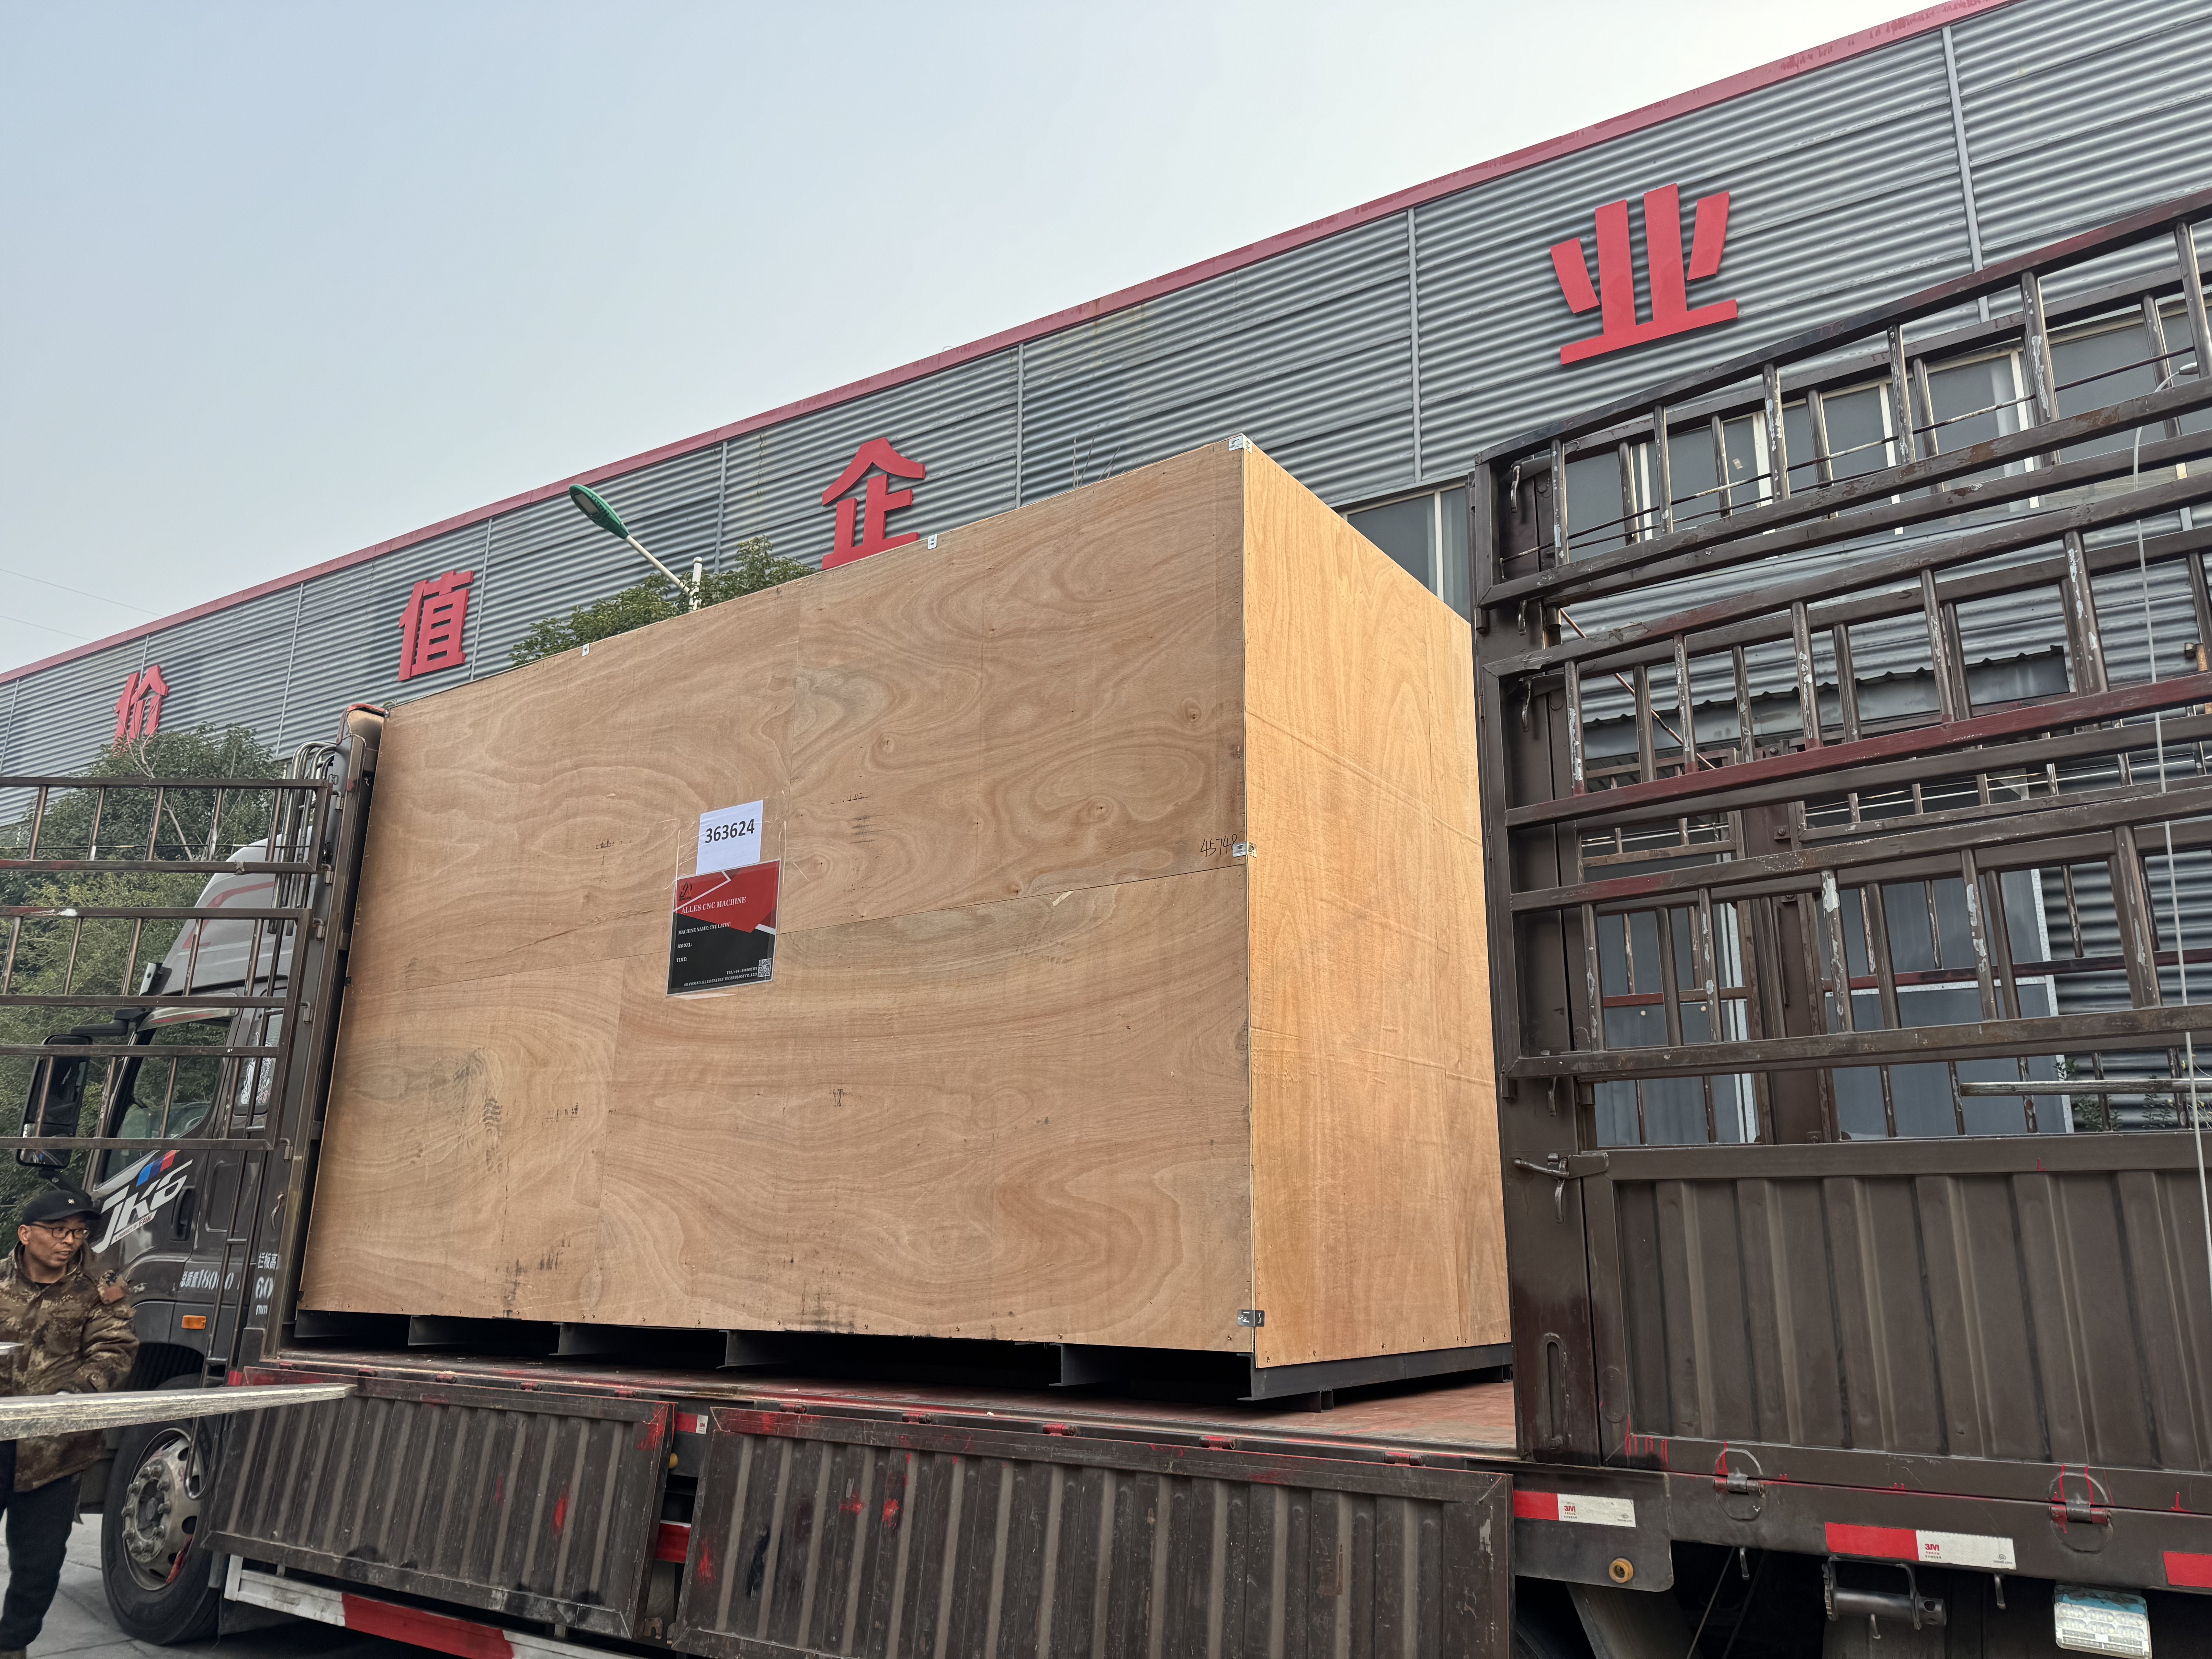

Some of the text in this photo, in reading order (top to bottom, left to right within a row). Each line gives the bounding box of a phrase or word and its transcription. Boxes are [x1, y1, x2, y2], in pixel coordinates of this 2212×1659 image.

[112, 183, 1738, 757] 价 值 企 业
[705, 819, 755, 843] 363624
[681, 896, 746, 914] ALLES CNC MACHINE
[139, 1214, 152, 1227] FAW
[256, 1304, 268, 1315] mm
